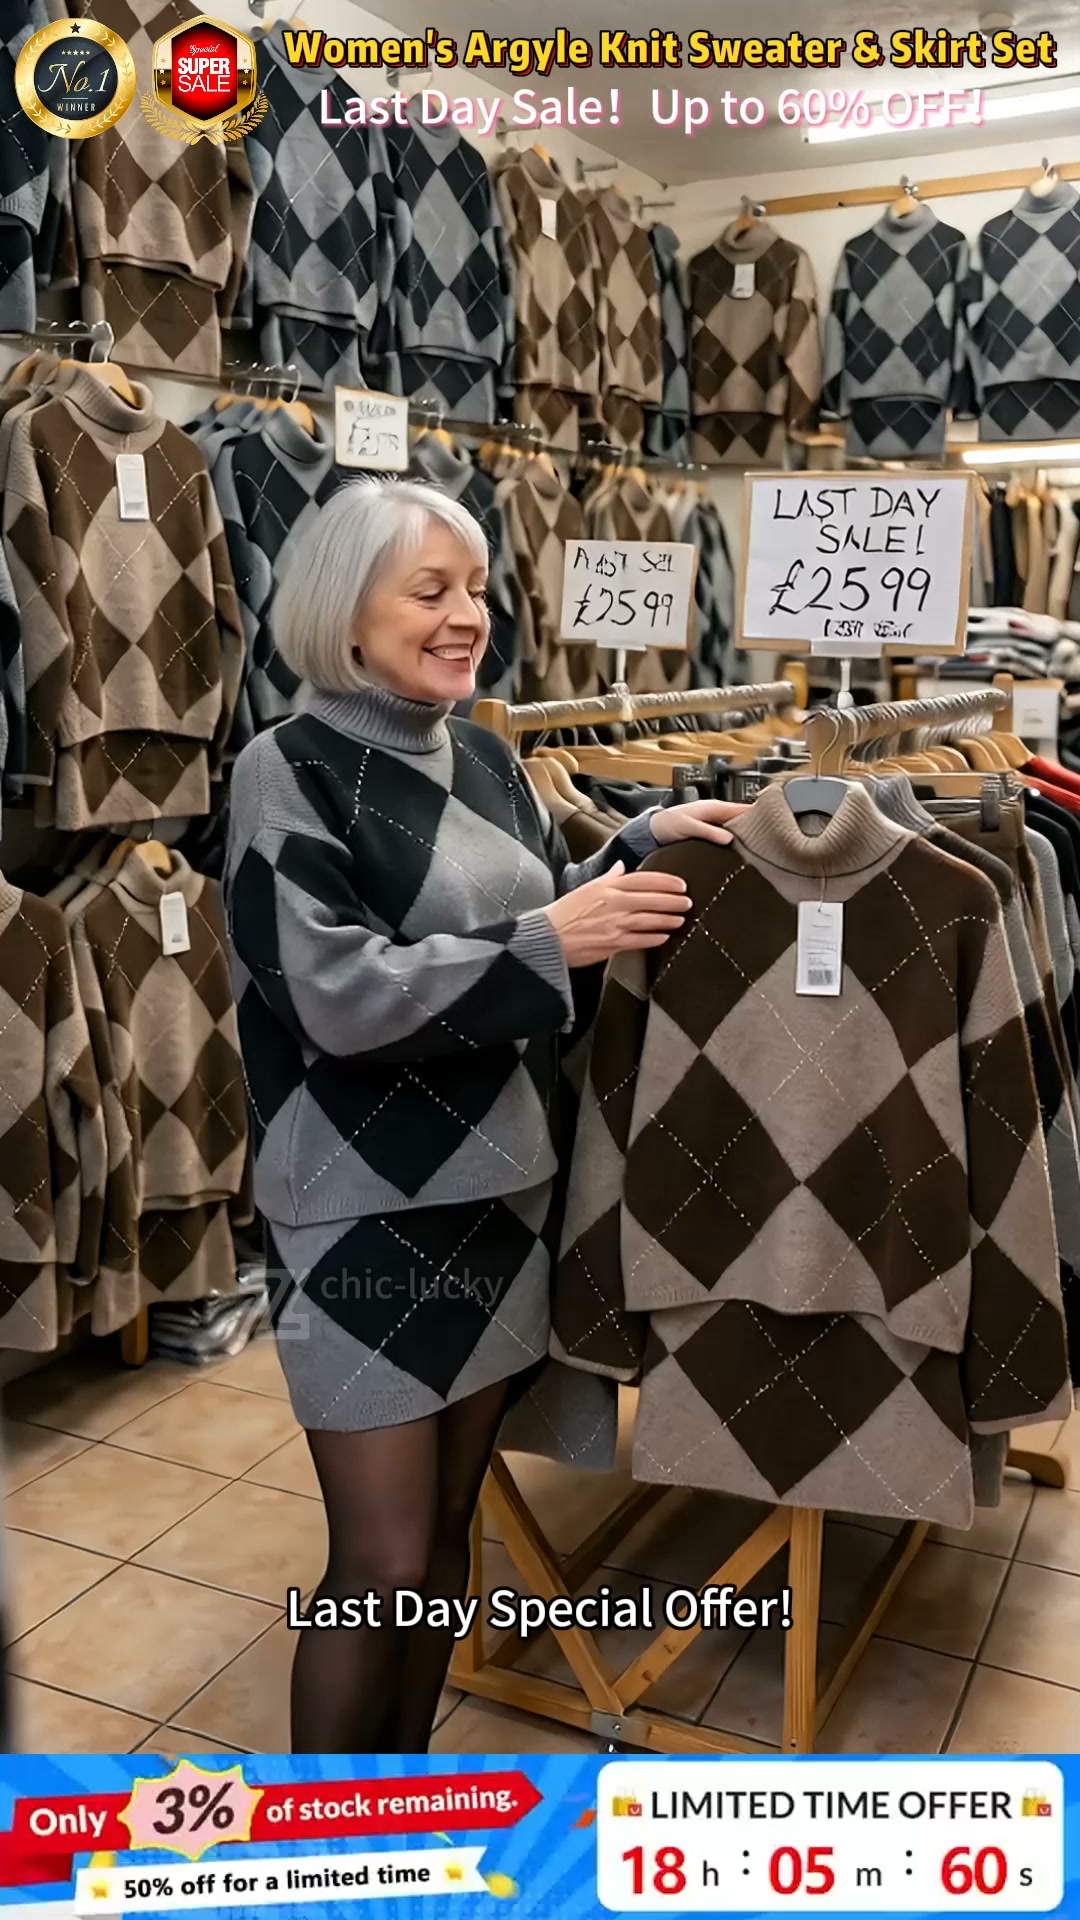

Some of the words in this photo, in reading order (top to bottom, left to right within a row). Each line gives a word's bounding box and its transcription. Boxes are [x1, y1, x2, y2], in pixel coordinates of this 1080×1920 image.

[773, 488, 857, 521] LAST
[869, 486, 942, 518] DAY
[816, 524, 925, 556] SALE!
